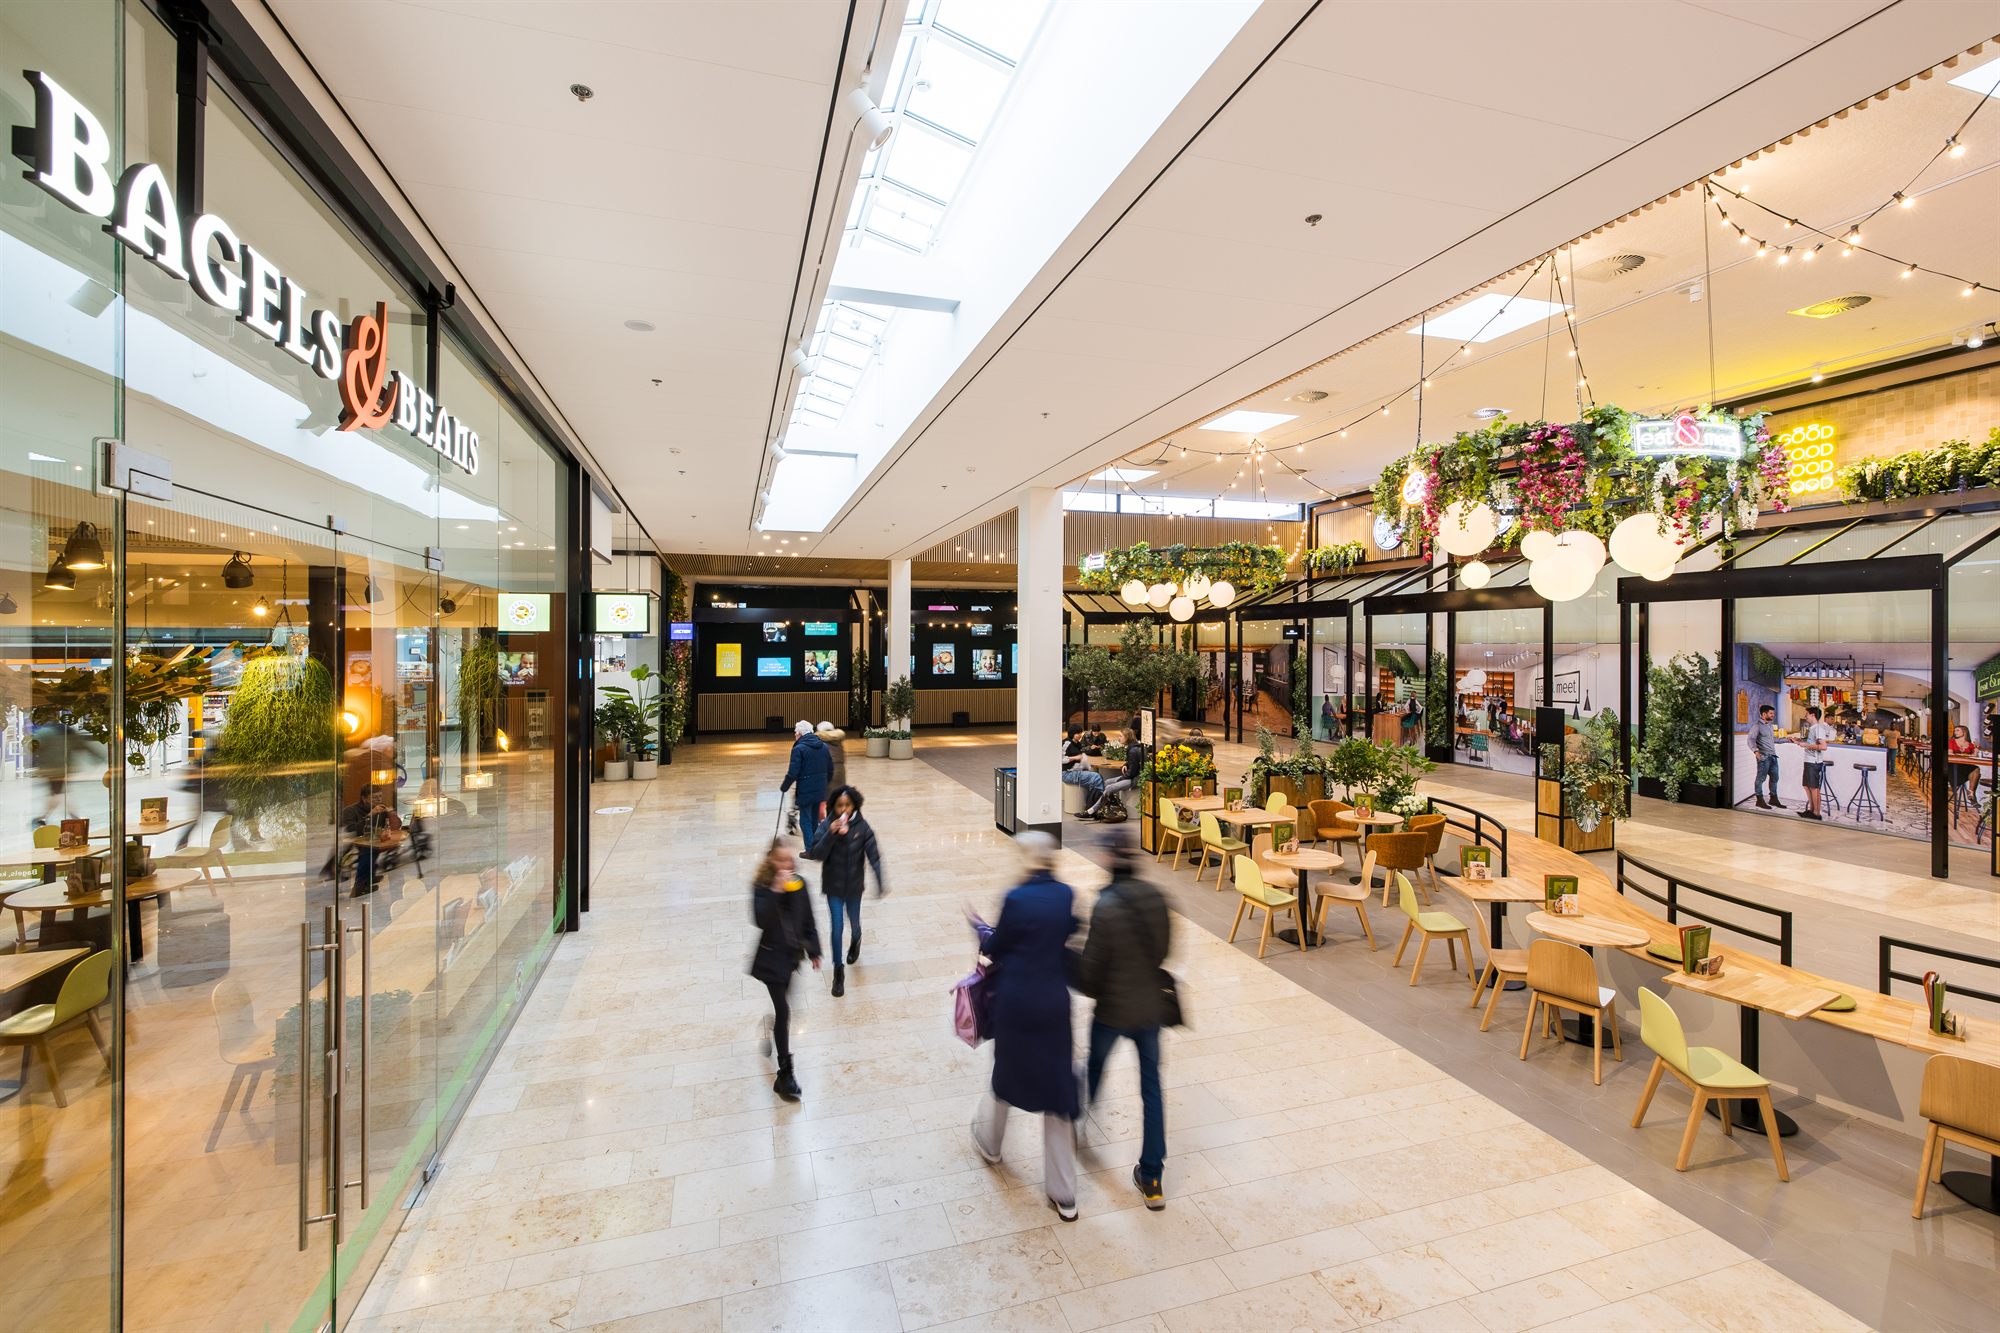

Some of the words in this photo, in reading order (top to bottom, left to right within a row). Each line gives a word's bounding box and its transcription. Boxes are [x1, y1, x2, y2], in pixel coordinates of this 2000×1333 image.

[23, 69, 341, 381] BAGELS
[336, 302, 397, 432] &
[391, 371, 479, 475] BEANS
[1641, 426, 1675, 446] eat
[1675, 415, 1704, 446] &
[1779, 424, 1834, 446] GOOD
[1782, 443, 1834, 460] OOD
[1790, 461, 1834, 476] OOD
[1790, 476, 1834, 493] OOD
[1556, 680, 1576, 693] meet
